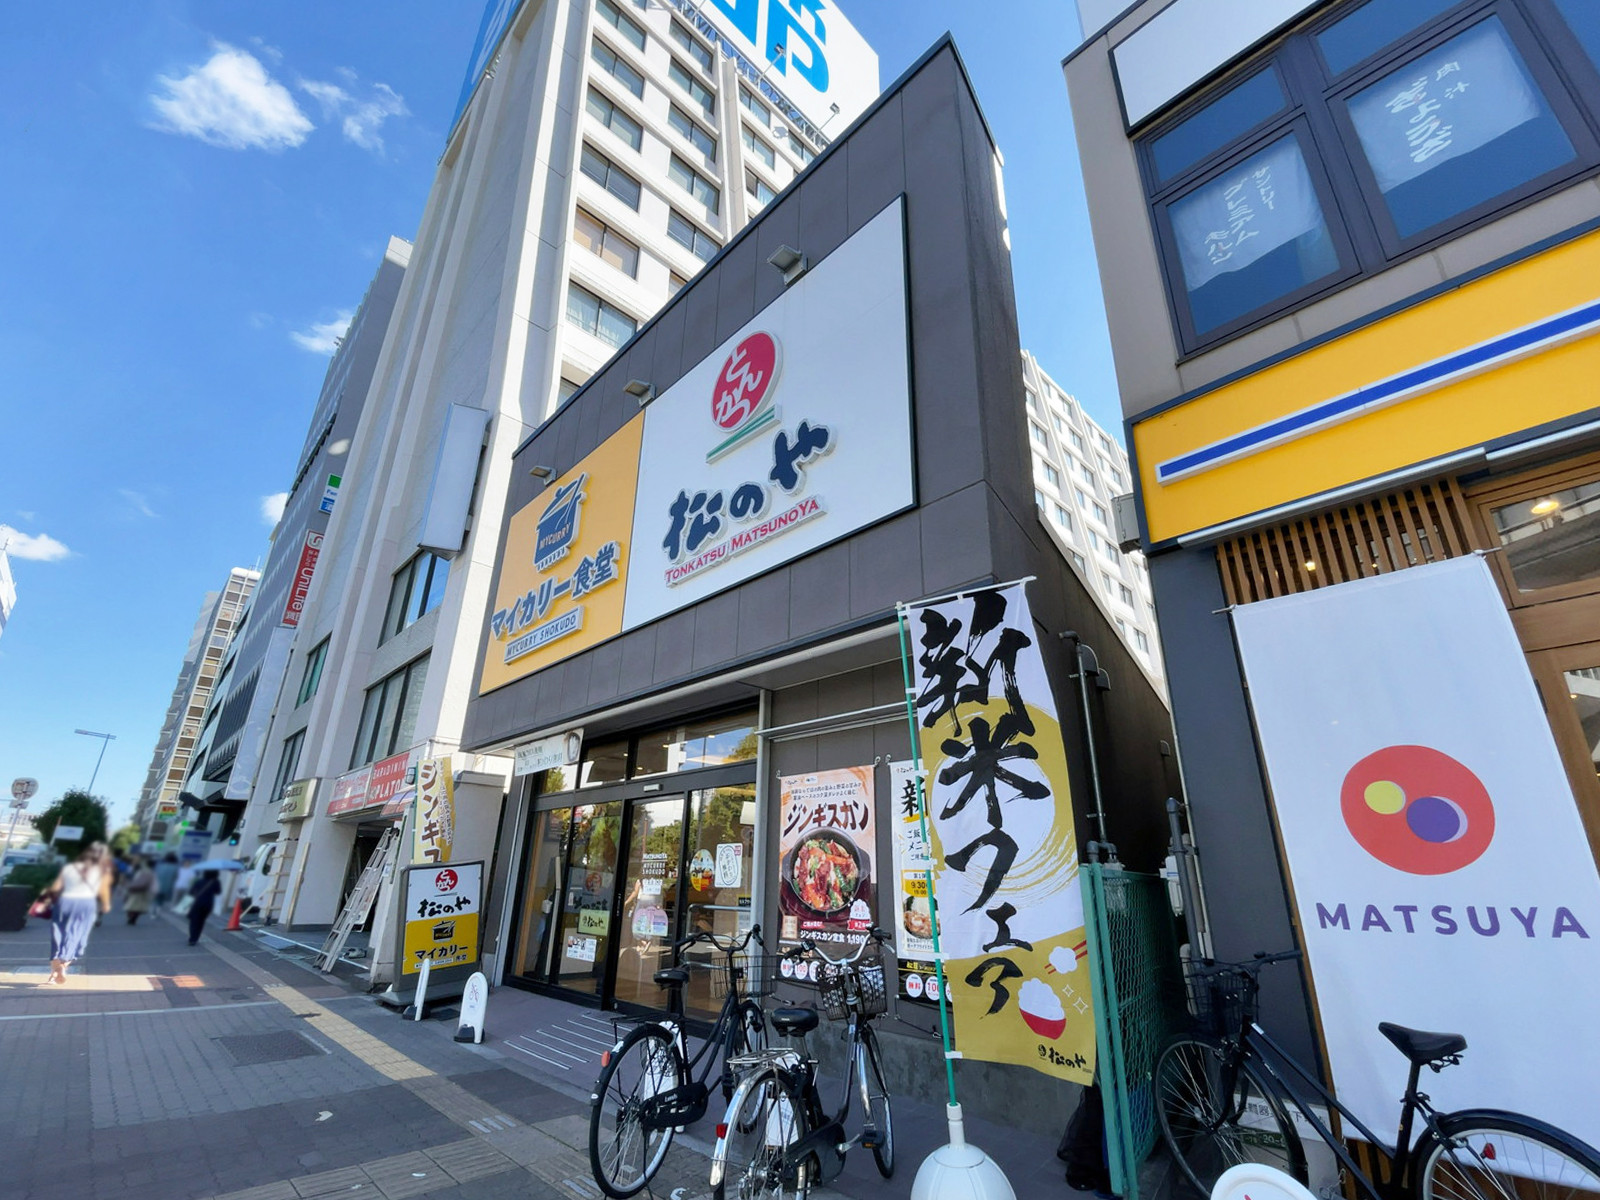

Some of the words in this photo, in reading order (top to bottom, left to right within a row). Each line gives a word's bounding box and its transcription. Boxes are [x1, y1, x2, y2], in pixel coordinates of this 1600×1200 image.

[1436, 61, 1470, 99] 肉汁
[663, 421, 829, 560] 松のや
[539, 522, 571, 550] MYCURRY
[665, 546, 726, 583] TONKATSU
[731, 499, 820, 551] MATSUNOYA
[492, 543, 615, 636] マイカリー食堂
[506, 636, 537, 657] MYCURRY
[540, 615, 576, 642] SHOKUDO
[783, 799, 869, 837] ジンギスカン
[916, 589, 1052, 1018] 新米フェア
[417, 895, 471, 917] 松のや
[1316, 902, 1591, 939] MATSUYA
[415, 944, 468, 960] マイカリー
[1049, 1046, 1087, 1069] 松のや
